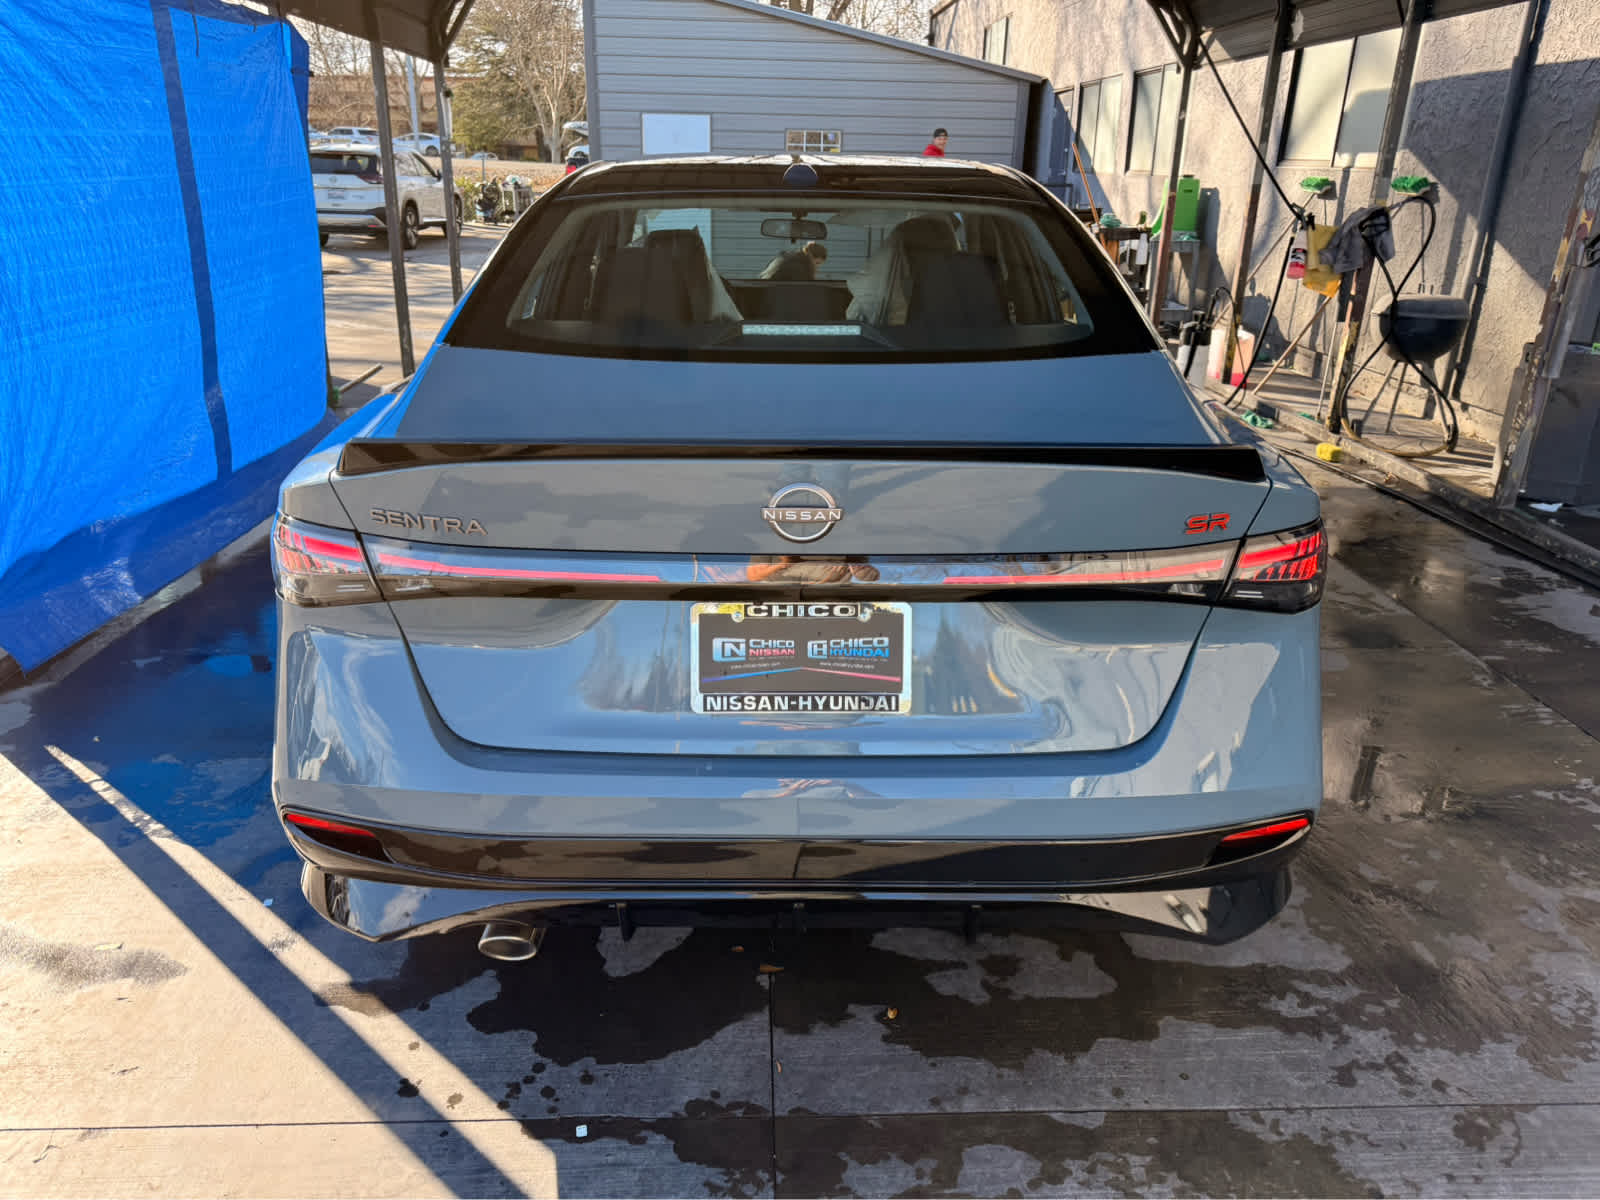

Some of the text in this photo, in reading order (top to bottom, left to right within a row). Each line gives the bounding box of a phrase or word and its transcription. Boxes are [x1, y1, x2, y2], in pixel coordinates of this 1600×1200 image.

[762, 510, 842, 521] NISSAN
[369, 507, 488, 537] SENTRA
[1185, 513, 1231, 535] SR
[746, 605, 856, 617] CHICO
[749, 639, 795, 649] CHICO
[829, 637, 889, 648] CHICO
[749, 649, 795, 657] NISSAN
[829, 648, 890, 658] HYUNDAI
[706, 695, 897, 711] NISSAN-HYUNDAI
